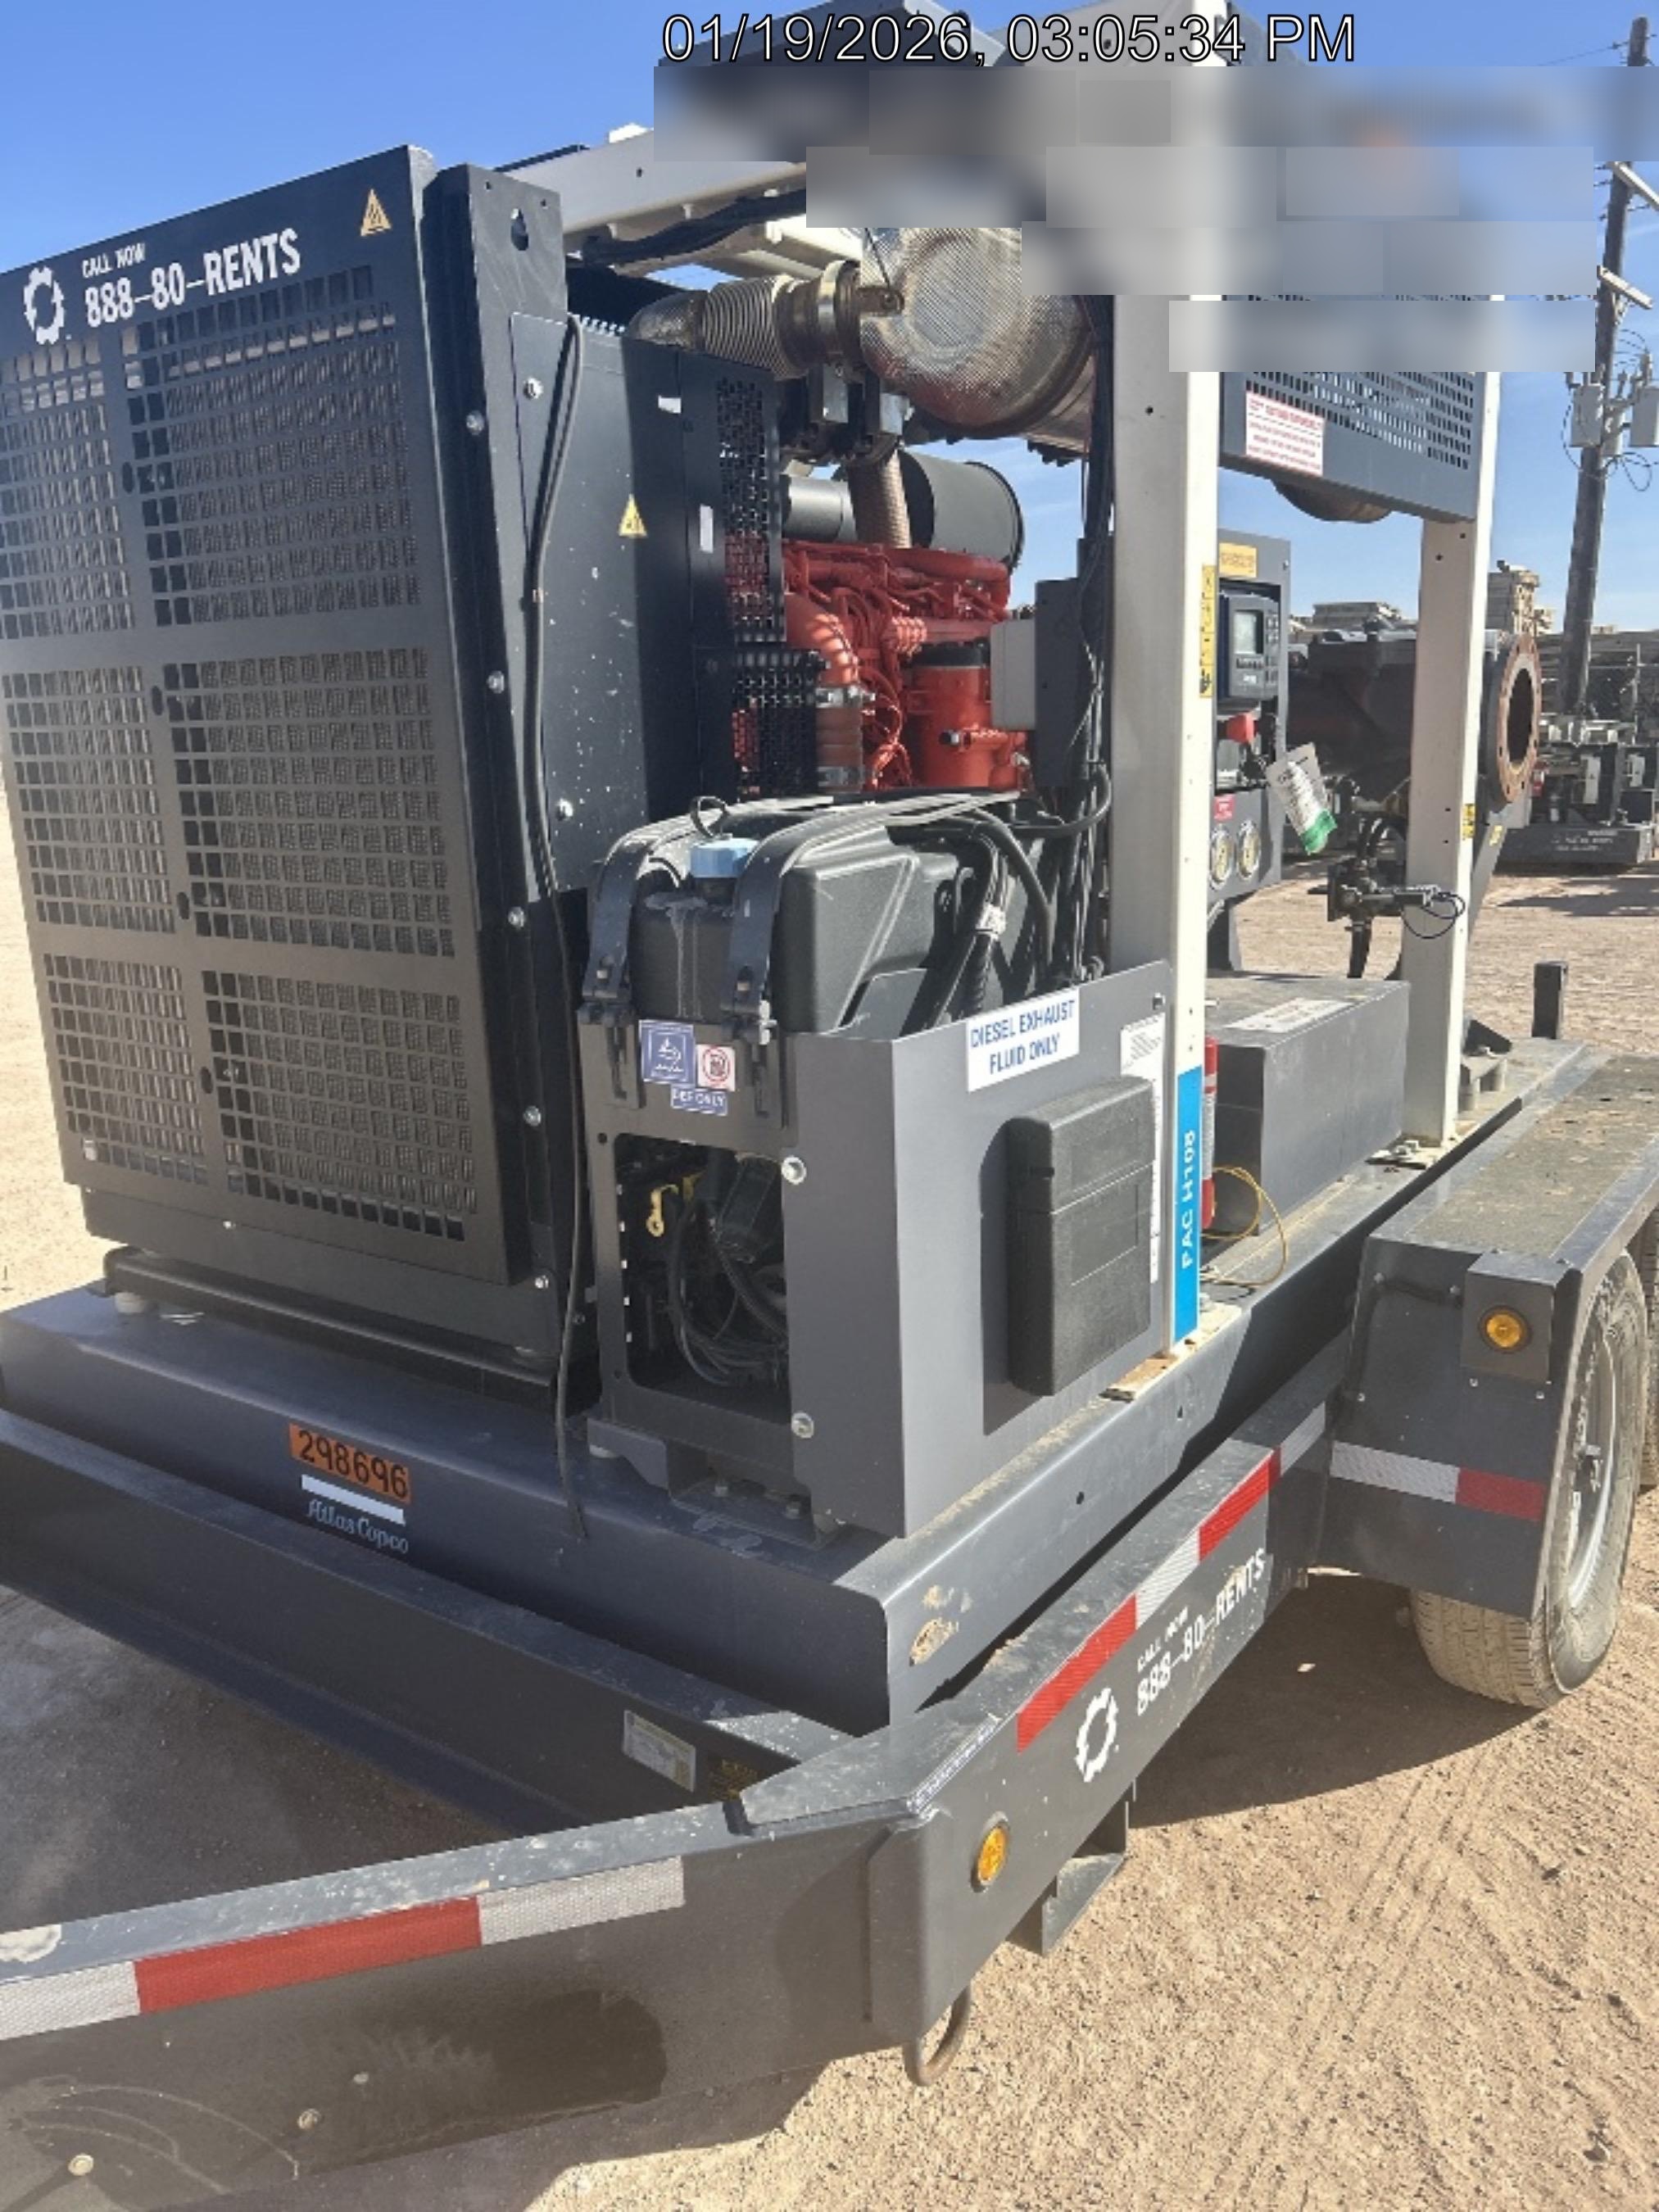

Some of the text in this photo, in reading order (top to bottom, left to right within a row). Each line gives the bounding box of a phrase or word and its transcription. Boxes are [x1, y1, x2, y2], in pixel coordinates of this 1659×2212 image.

[82, 243, 146, 279] CALL NOW
[84, 228, 301, 328] 888-80-RENTS
[970, 999, 1075, 1048] DIESEL EXHAUST
[990, 1031, 1060, 1075] FLUID ONLY
[1181, 1130, 1195, 1269] PAC H108
[298, 1430, 409, 1498] 298696
[308, 1498, 408, 1554] Atlas Copco
[1137, 1547, 1266, 1716] 888-80-RENTS
